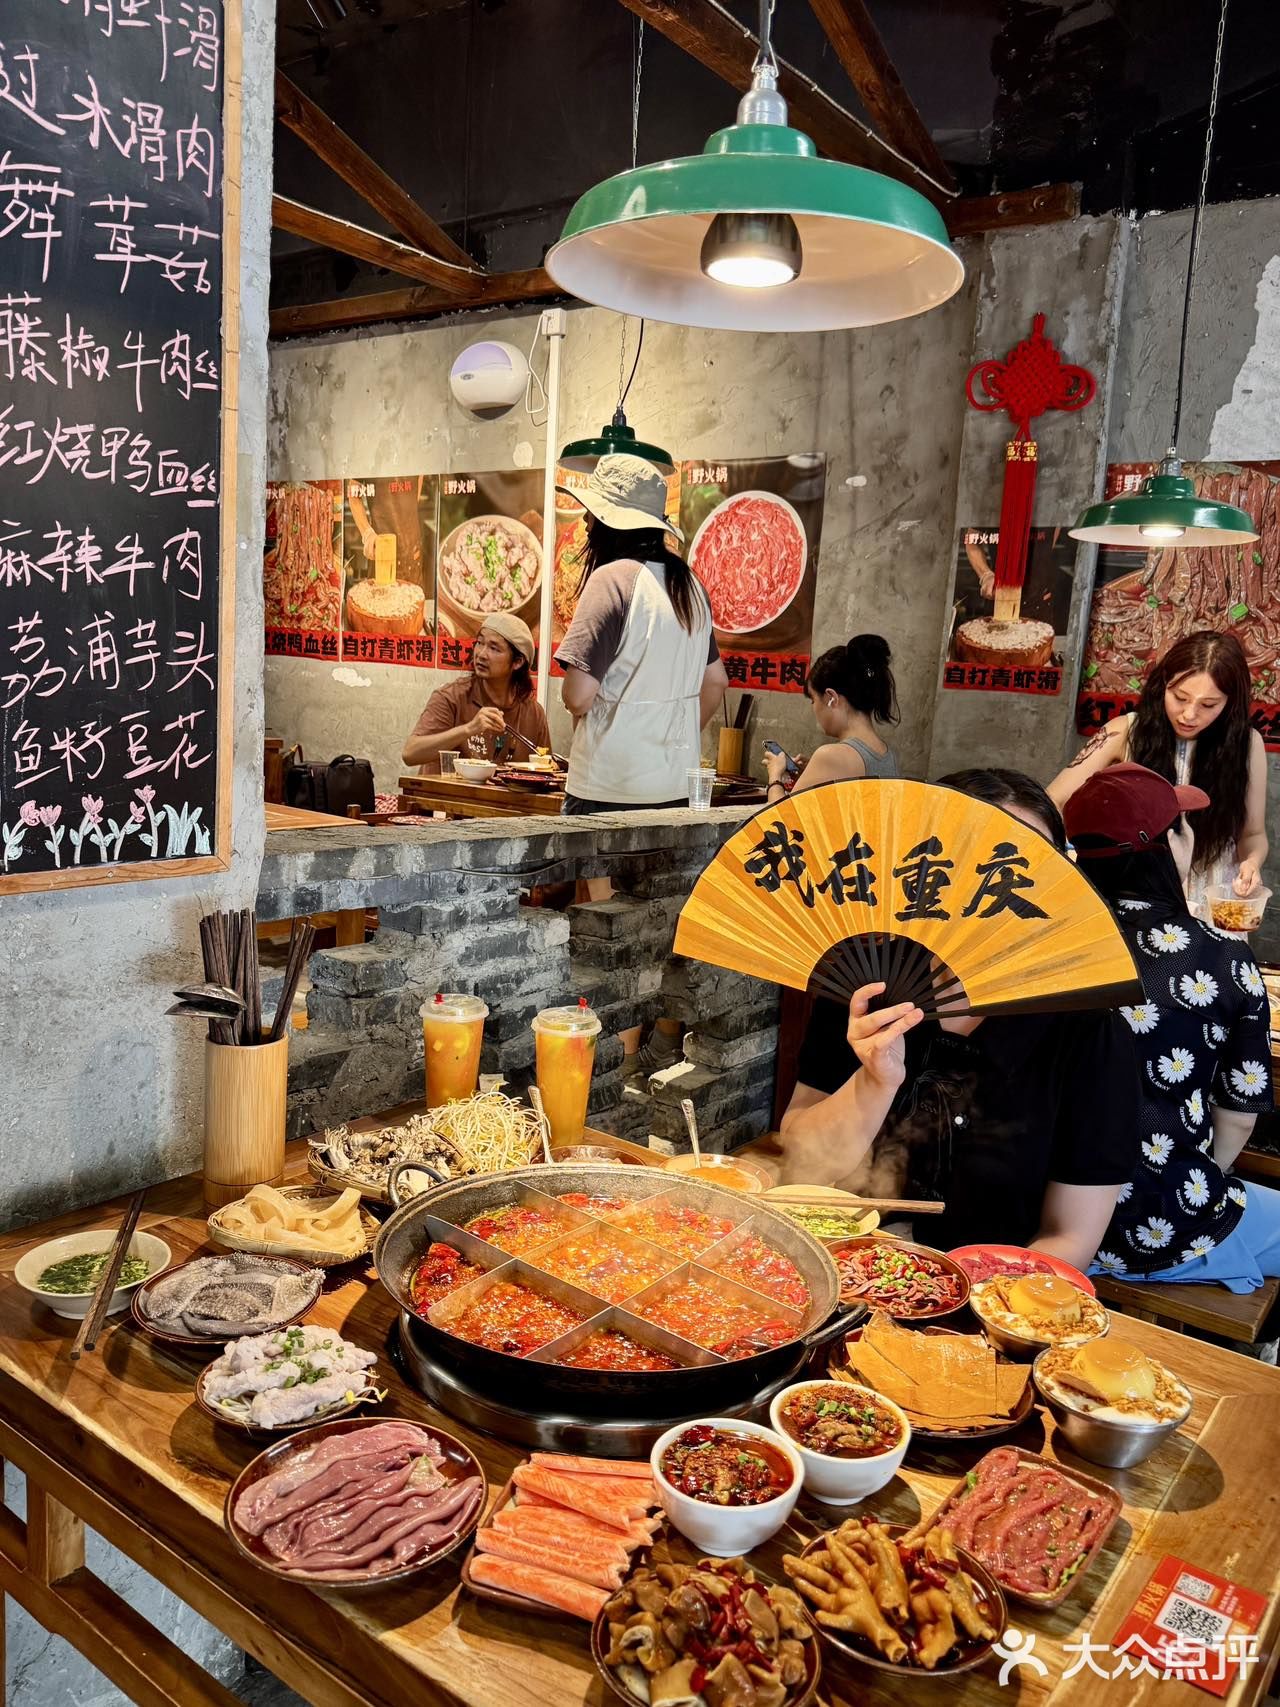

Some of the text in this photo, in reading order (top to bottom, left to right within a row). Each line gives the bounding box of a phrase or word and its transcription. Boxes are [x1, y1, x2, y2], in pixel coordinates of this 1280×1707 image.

[0, 43, 214, 198] 过水滑肉
[0, 403, 217, 507] 红烧鸭血丝
[448, 479, 476, 495] 野火锅
[692, 466, 728, 484] 野火锅
[0, 519, 202, 600] 麻辣牛肉
[1, 609, 215, 708] 荔浦芋头
[342, 634, 434, 662] 自打青虾滑
[946, 665, 1060, 691] 自打青虾滑
[13, 710, 214, 789] 鱼籽豆花
[743, 821, 1052, 922] 我在重庆
